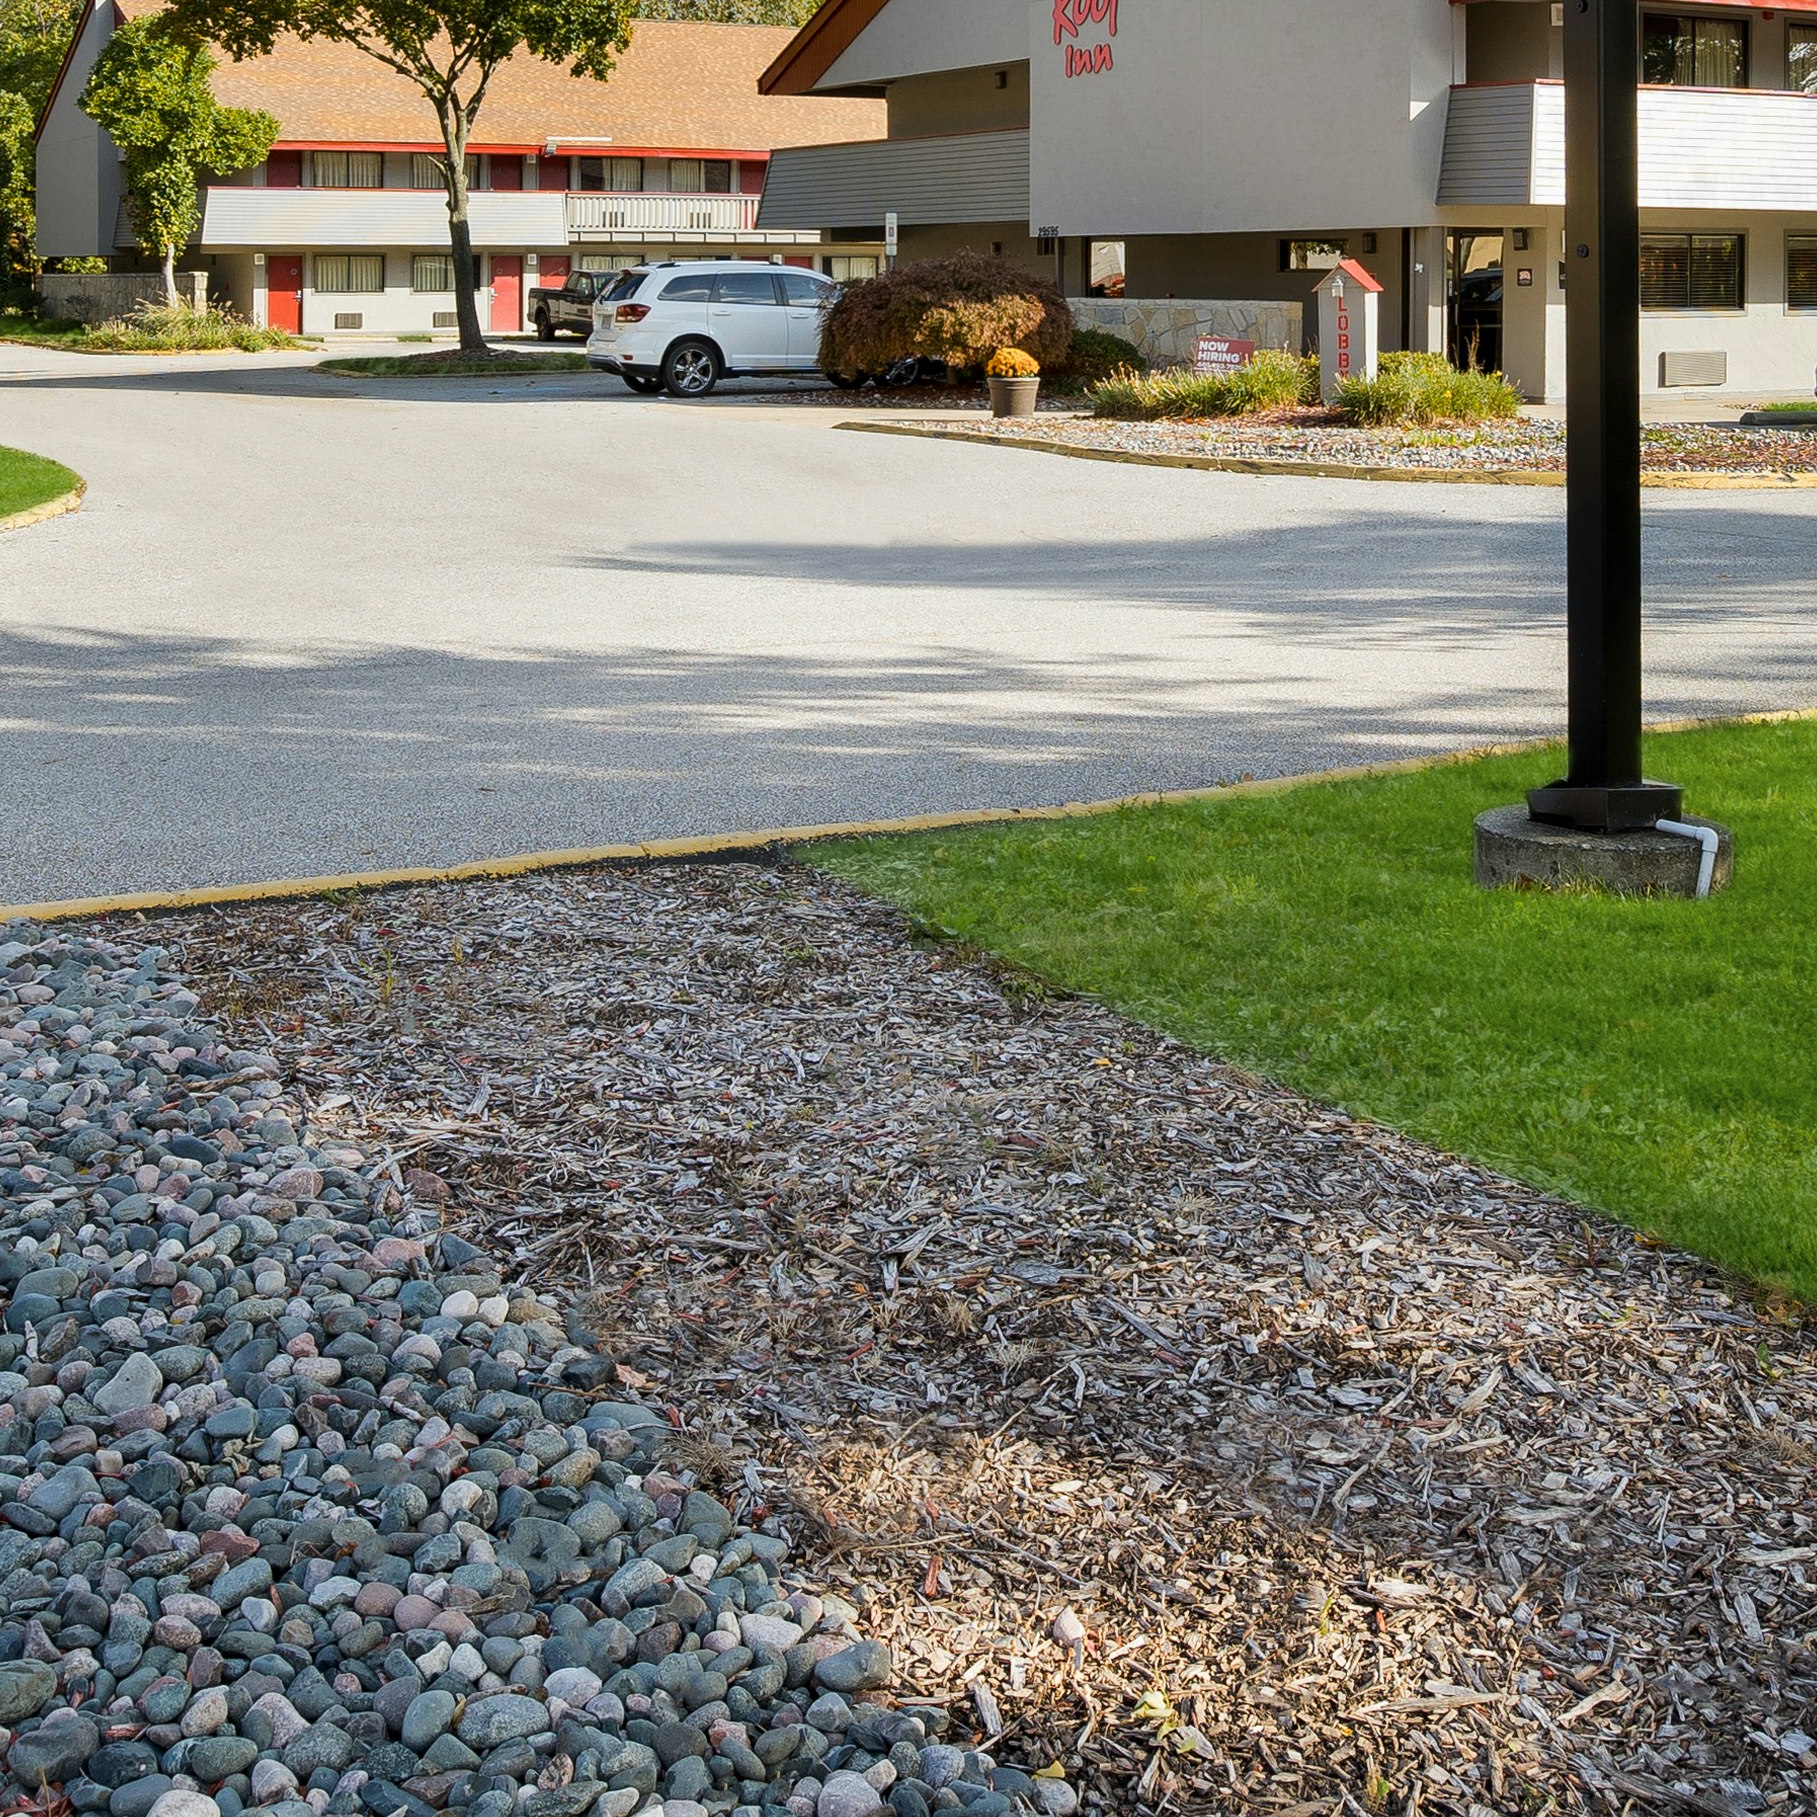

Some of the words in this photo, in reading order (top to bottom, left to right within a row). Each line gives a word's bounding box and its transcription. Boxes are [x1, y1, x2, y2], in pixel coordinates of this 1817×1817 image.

[1065, 43, 1113, 78] Inn
[1198, 340, 1230, 352] NOW
[1197, 350, 1240, 364] HIRING
